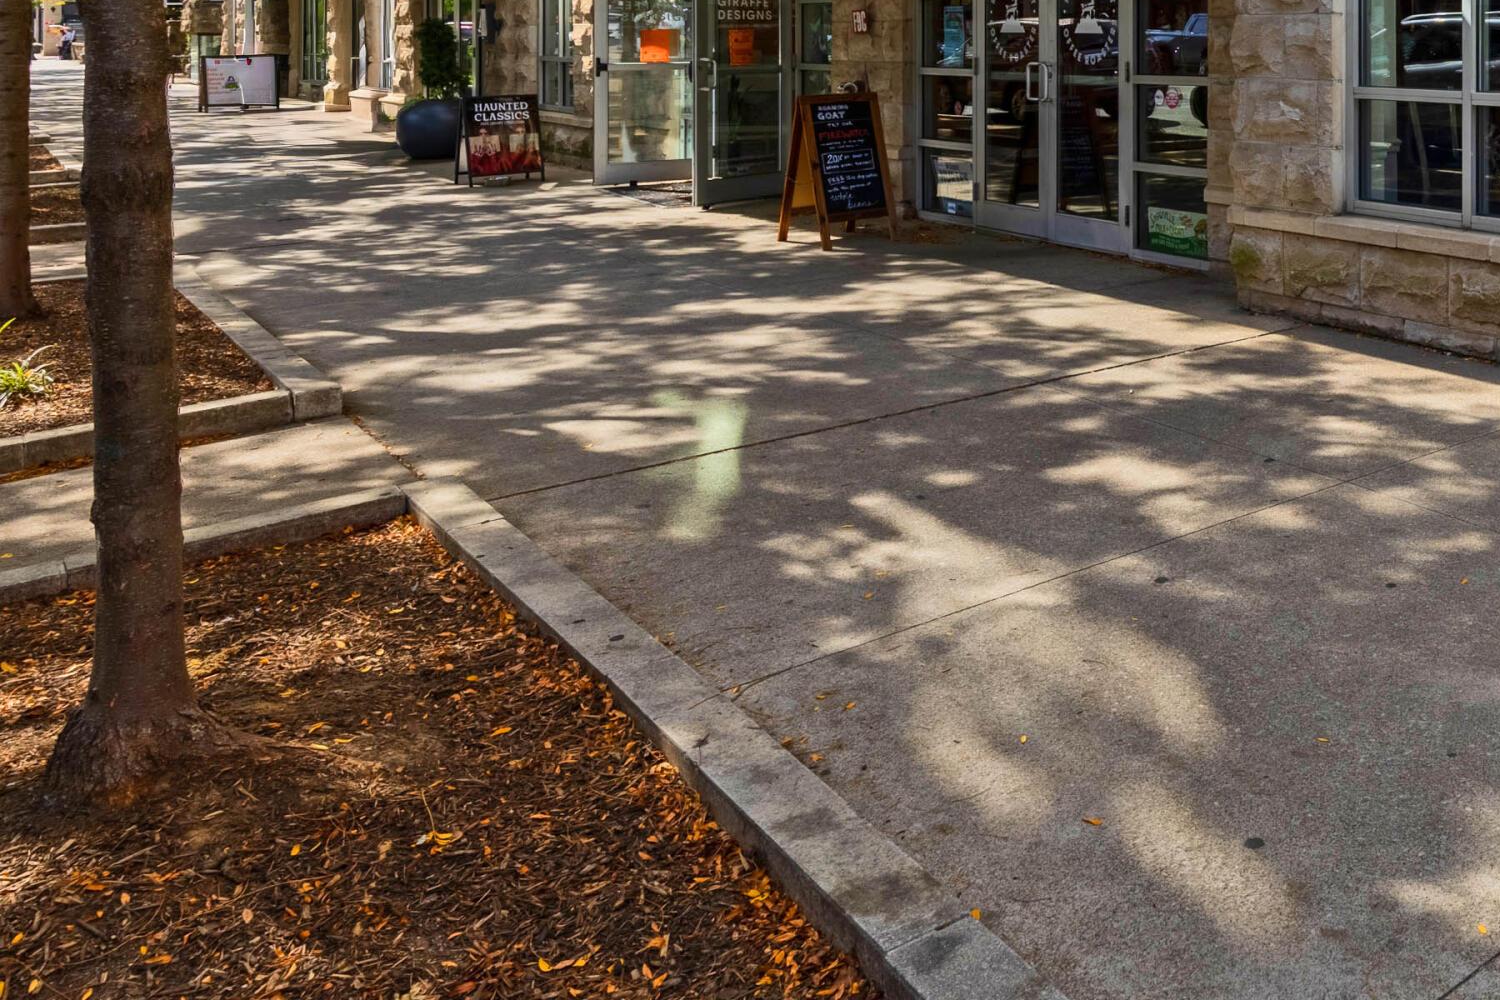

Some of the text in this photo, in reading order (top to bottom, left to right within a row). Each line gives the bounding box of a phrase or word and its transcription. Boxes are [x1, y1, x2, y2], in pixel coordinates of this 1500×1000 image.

[717, 9, 772, 20] DESIGNS
[474, 102, 528, 112] HAUNTED
[474, 111, 530, 121] CLASSICS
[817, 111, 846, 120] GOAT
